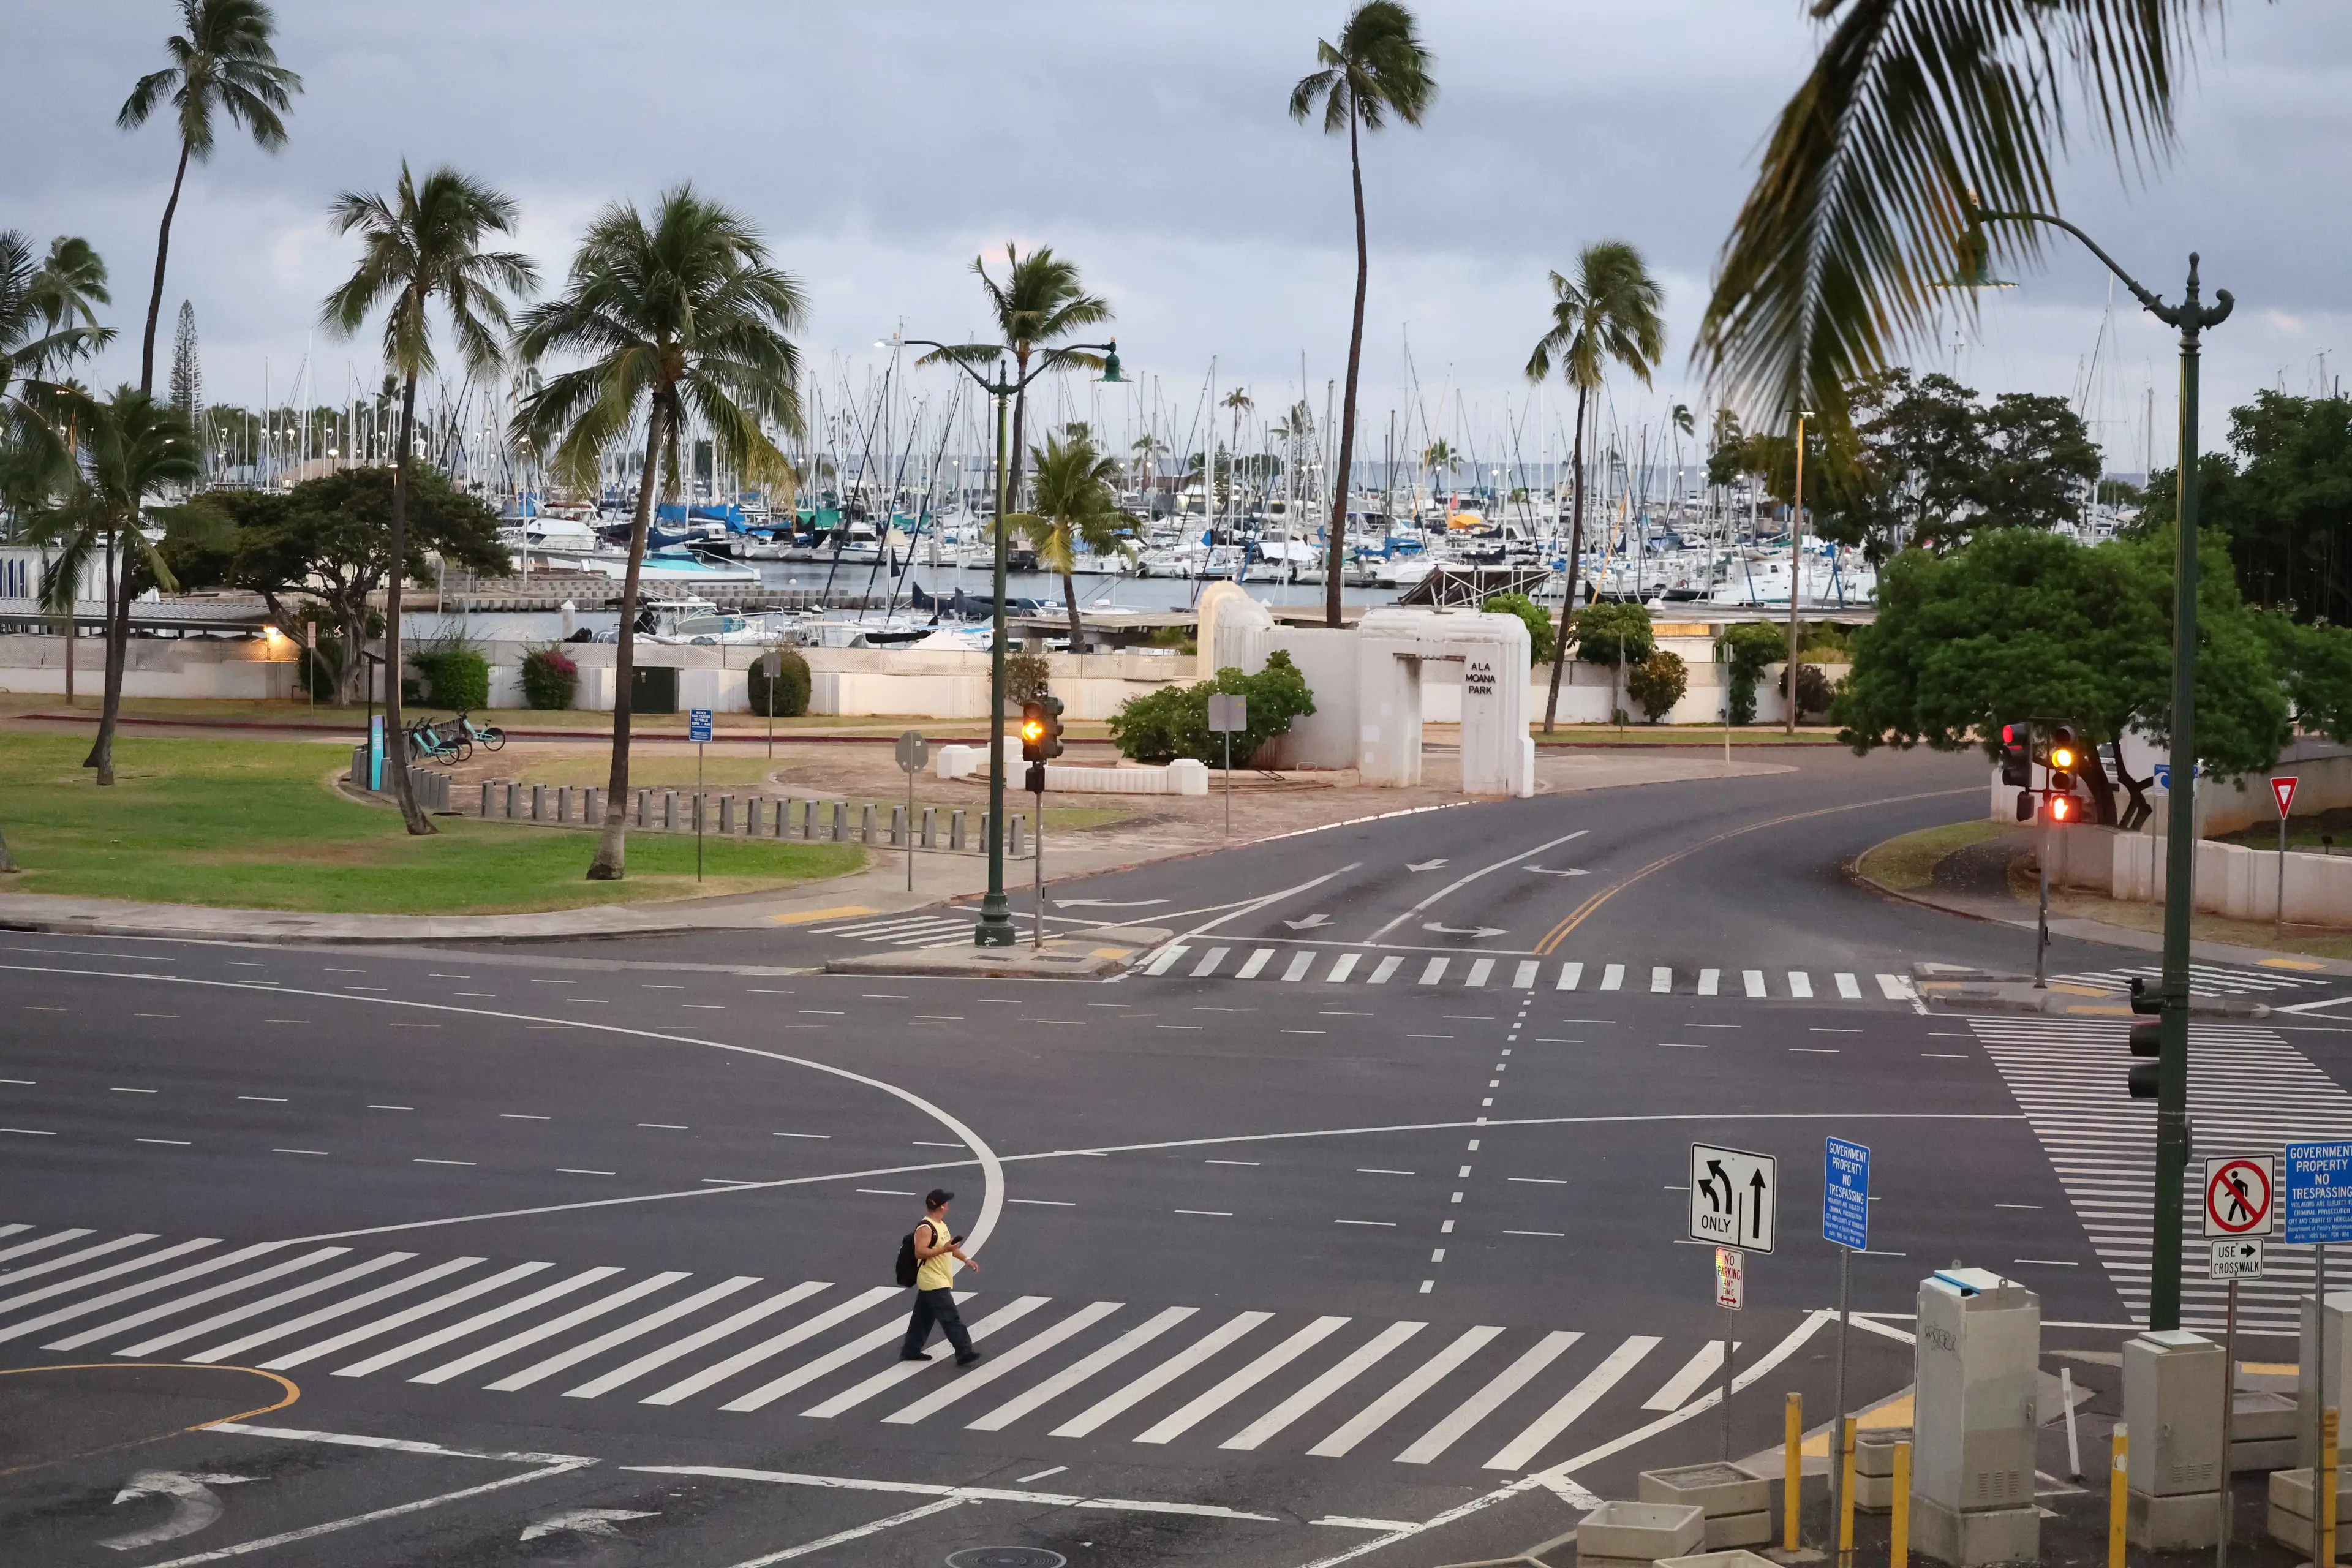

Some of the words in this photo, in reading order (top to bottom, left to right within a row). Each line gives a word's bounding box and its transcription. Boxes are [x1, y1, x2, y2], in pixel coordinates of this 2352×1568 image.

[1471, 662, 1490, 671] ALA
[1465, 674, 1496, 683] MOANA
[1468, 685, 1493, 695] PARK
[1829, 1142, 1867, 1163] GOVERNMENT
[1832, 1157, 1863, 1176] PROPERTY
[2296, 1159, 2348, 1172] PROPERTY
[1842, 1174, 1852, 1186] NO
[2315, 1174, 2330, 1185] NO
[1829, 1183, 1864, 1204] TRESPASSING
[2292, 1186, 2352, 1199] TRESPASSING
[1702, 1215, 1731, 1233] ONLY
[2218, 1246, 2236, 1257] USE
[1724, 1254, 1735, 1266] NO
[1717, 1265, 1741, 1280] PARKING
[2214, 1261, 2259, 1274] CROSSWALK
[1723, 1279, 1734, 1287] ANY
[1722, 1287, 1734, 1297] TIME
